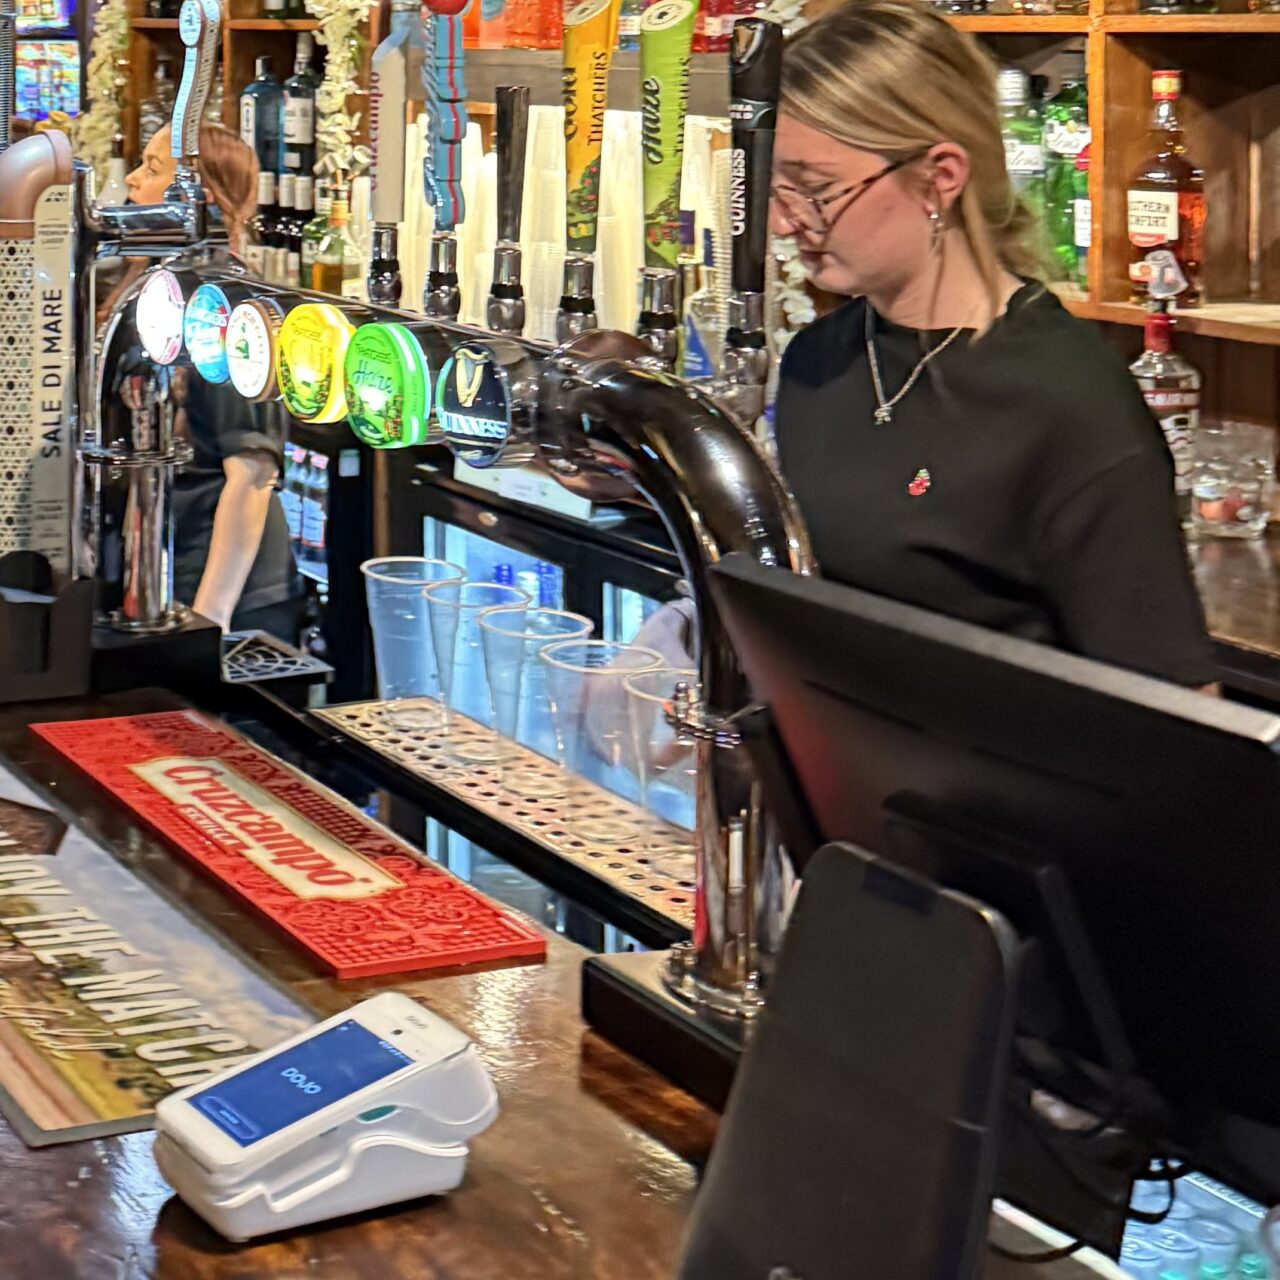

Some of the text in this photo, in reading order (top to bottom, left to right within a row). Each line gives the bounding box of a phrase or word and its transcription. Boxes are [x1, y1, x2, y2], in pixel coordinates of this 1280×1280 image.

[729, 148, 746, 236] GUINNESS
[42, 288, 62, 459] SALE DI MARE
[163, 764, 358, 886] Cruzcampo
[176, 803, 244, 848] SEVILLA
[1, 906, 141, 968] THE
[62, 968, 261, 1088] MATCH
